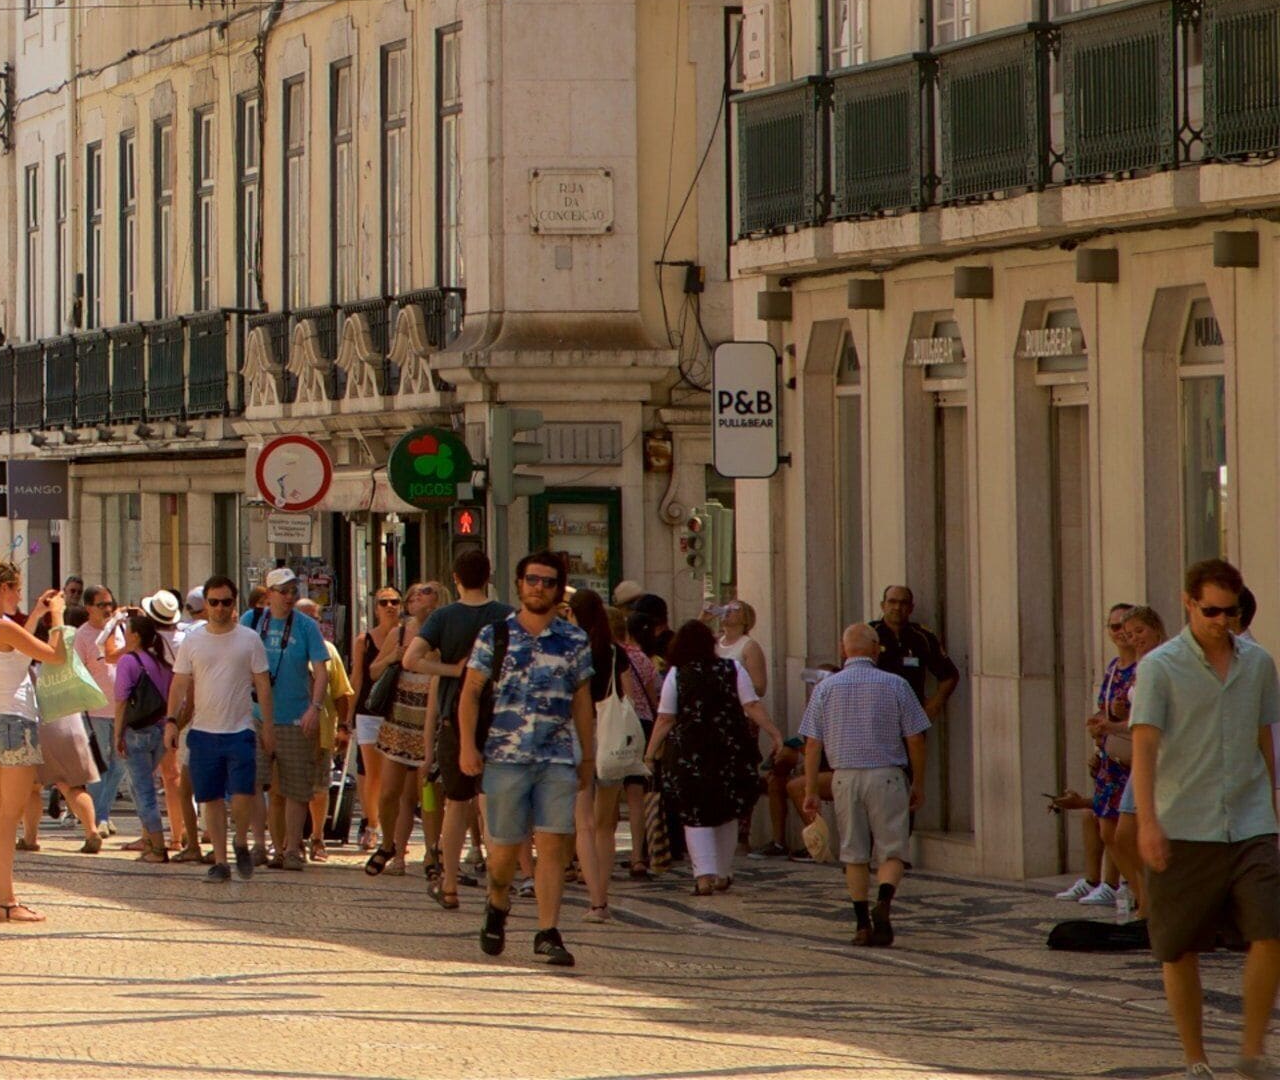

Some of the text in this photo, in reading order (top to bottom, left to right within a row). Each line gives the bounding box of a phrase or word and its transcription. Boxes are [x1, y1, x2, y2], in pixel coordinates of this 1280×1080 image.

[559, 182, 585, 194] RUA
[564, 196, 580, 208] DA
[718, 390, 773, 415] P&B
[718, 418, 774, 429] PULL&BEAR
[14, 484, 62, 495] MANGO
[407, 483, 454, 499] JOGOS
